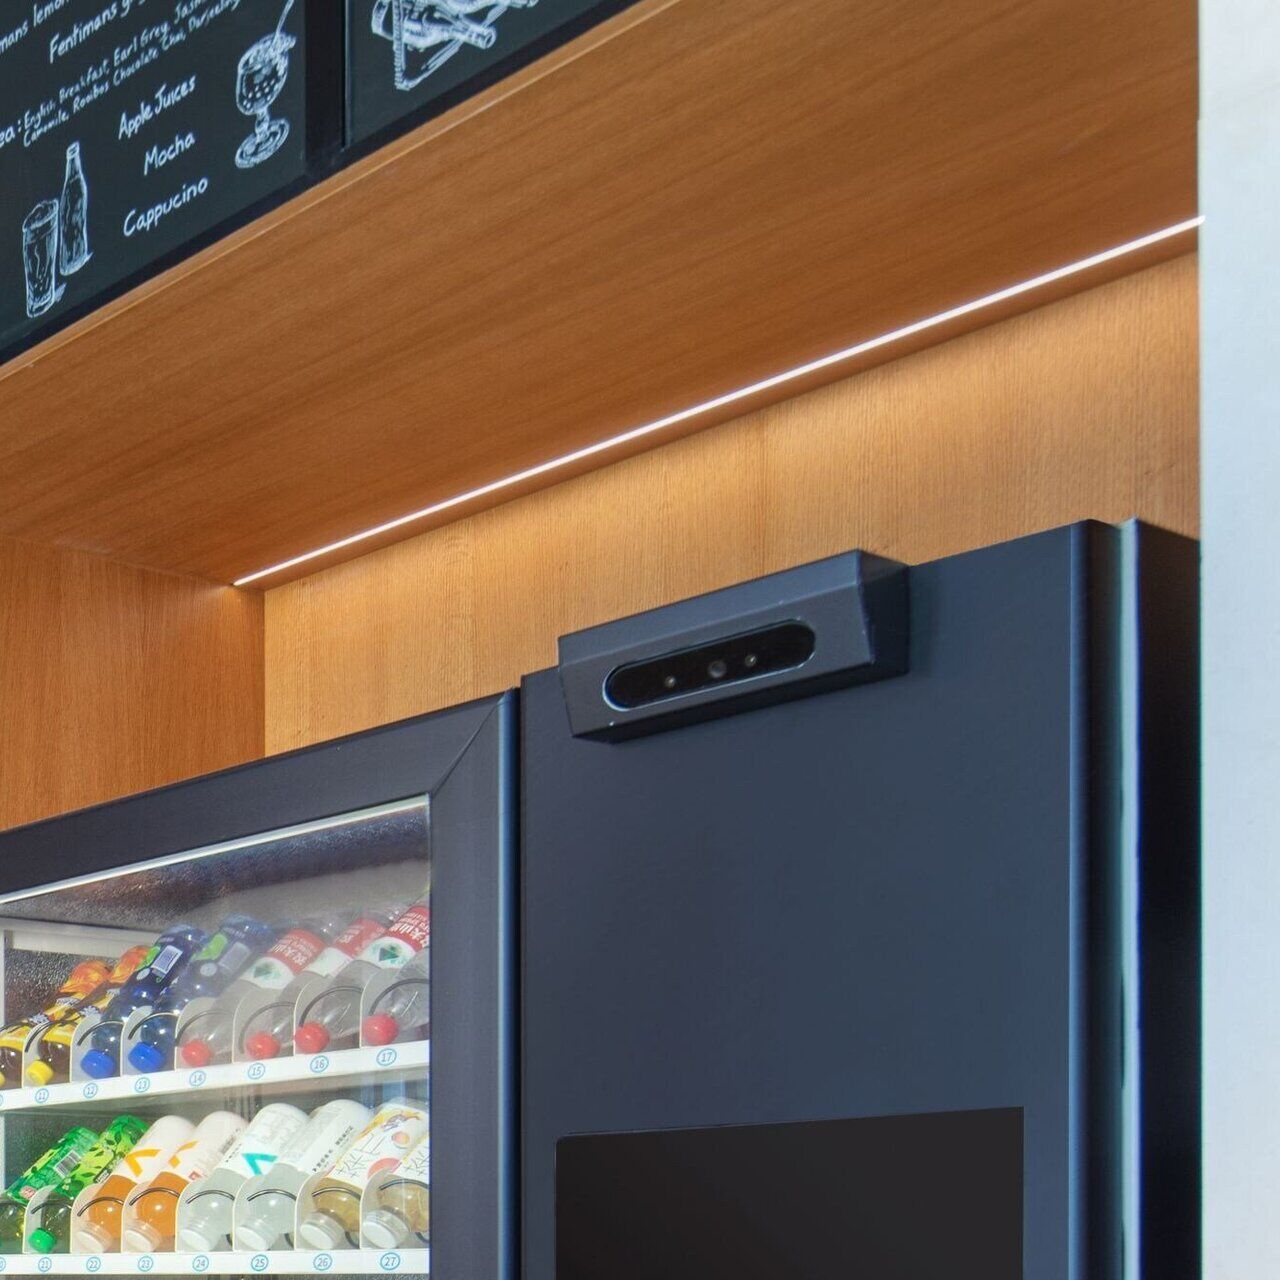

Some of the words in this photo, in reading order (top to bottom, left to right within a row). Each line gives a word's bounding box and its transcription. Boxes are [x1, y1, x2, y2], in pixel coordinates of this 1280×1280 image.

[49, 2, 117, 64] Fentimans
[114, 36, 138, 67] Earl
[118, 102, 153, 140] Apple
[155, 75, 197, 115] Juices
[143, 132, 196, 176] Mocha
[123, 177, 208, 237] Cappucino
[381, 1051, 392, 1064] 17
[251, 1066, 261, 1077] 15
[314, 1059, 325, 1071] 16
[138, 1080, 147, 1091] 13
[193, 1074, 202, 1085] 14
[141, 1259, 150, 1269] 23
[196, 1258, 205, 1269] 24
[255, 1257, 265, 1269] 25
[317, 1256, 328, 1269] 26
[384, 1255, 396, 1268] 27
